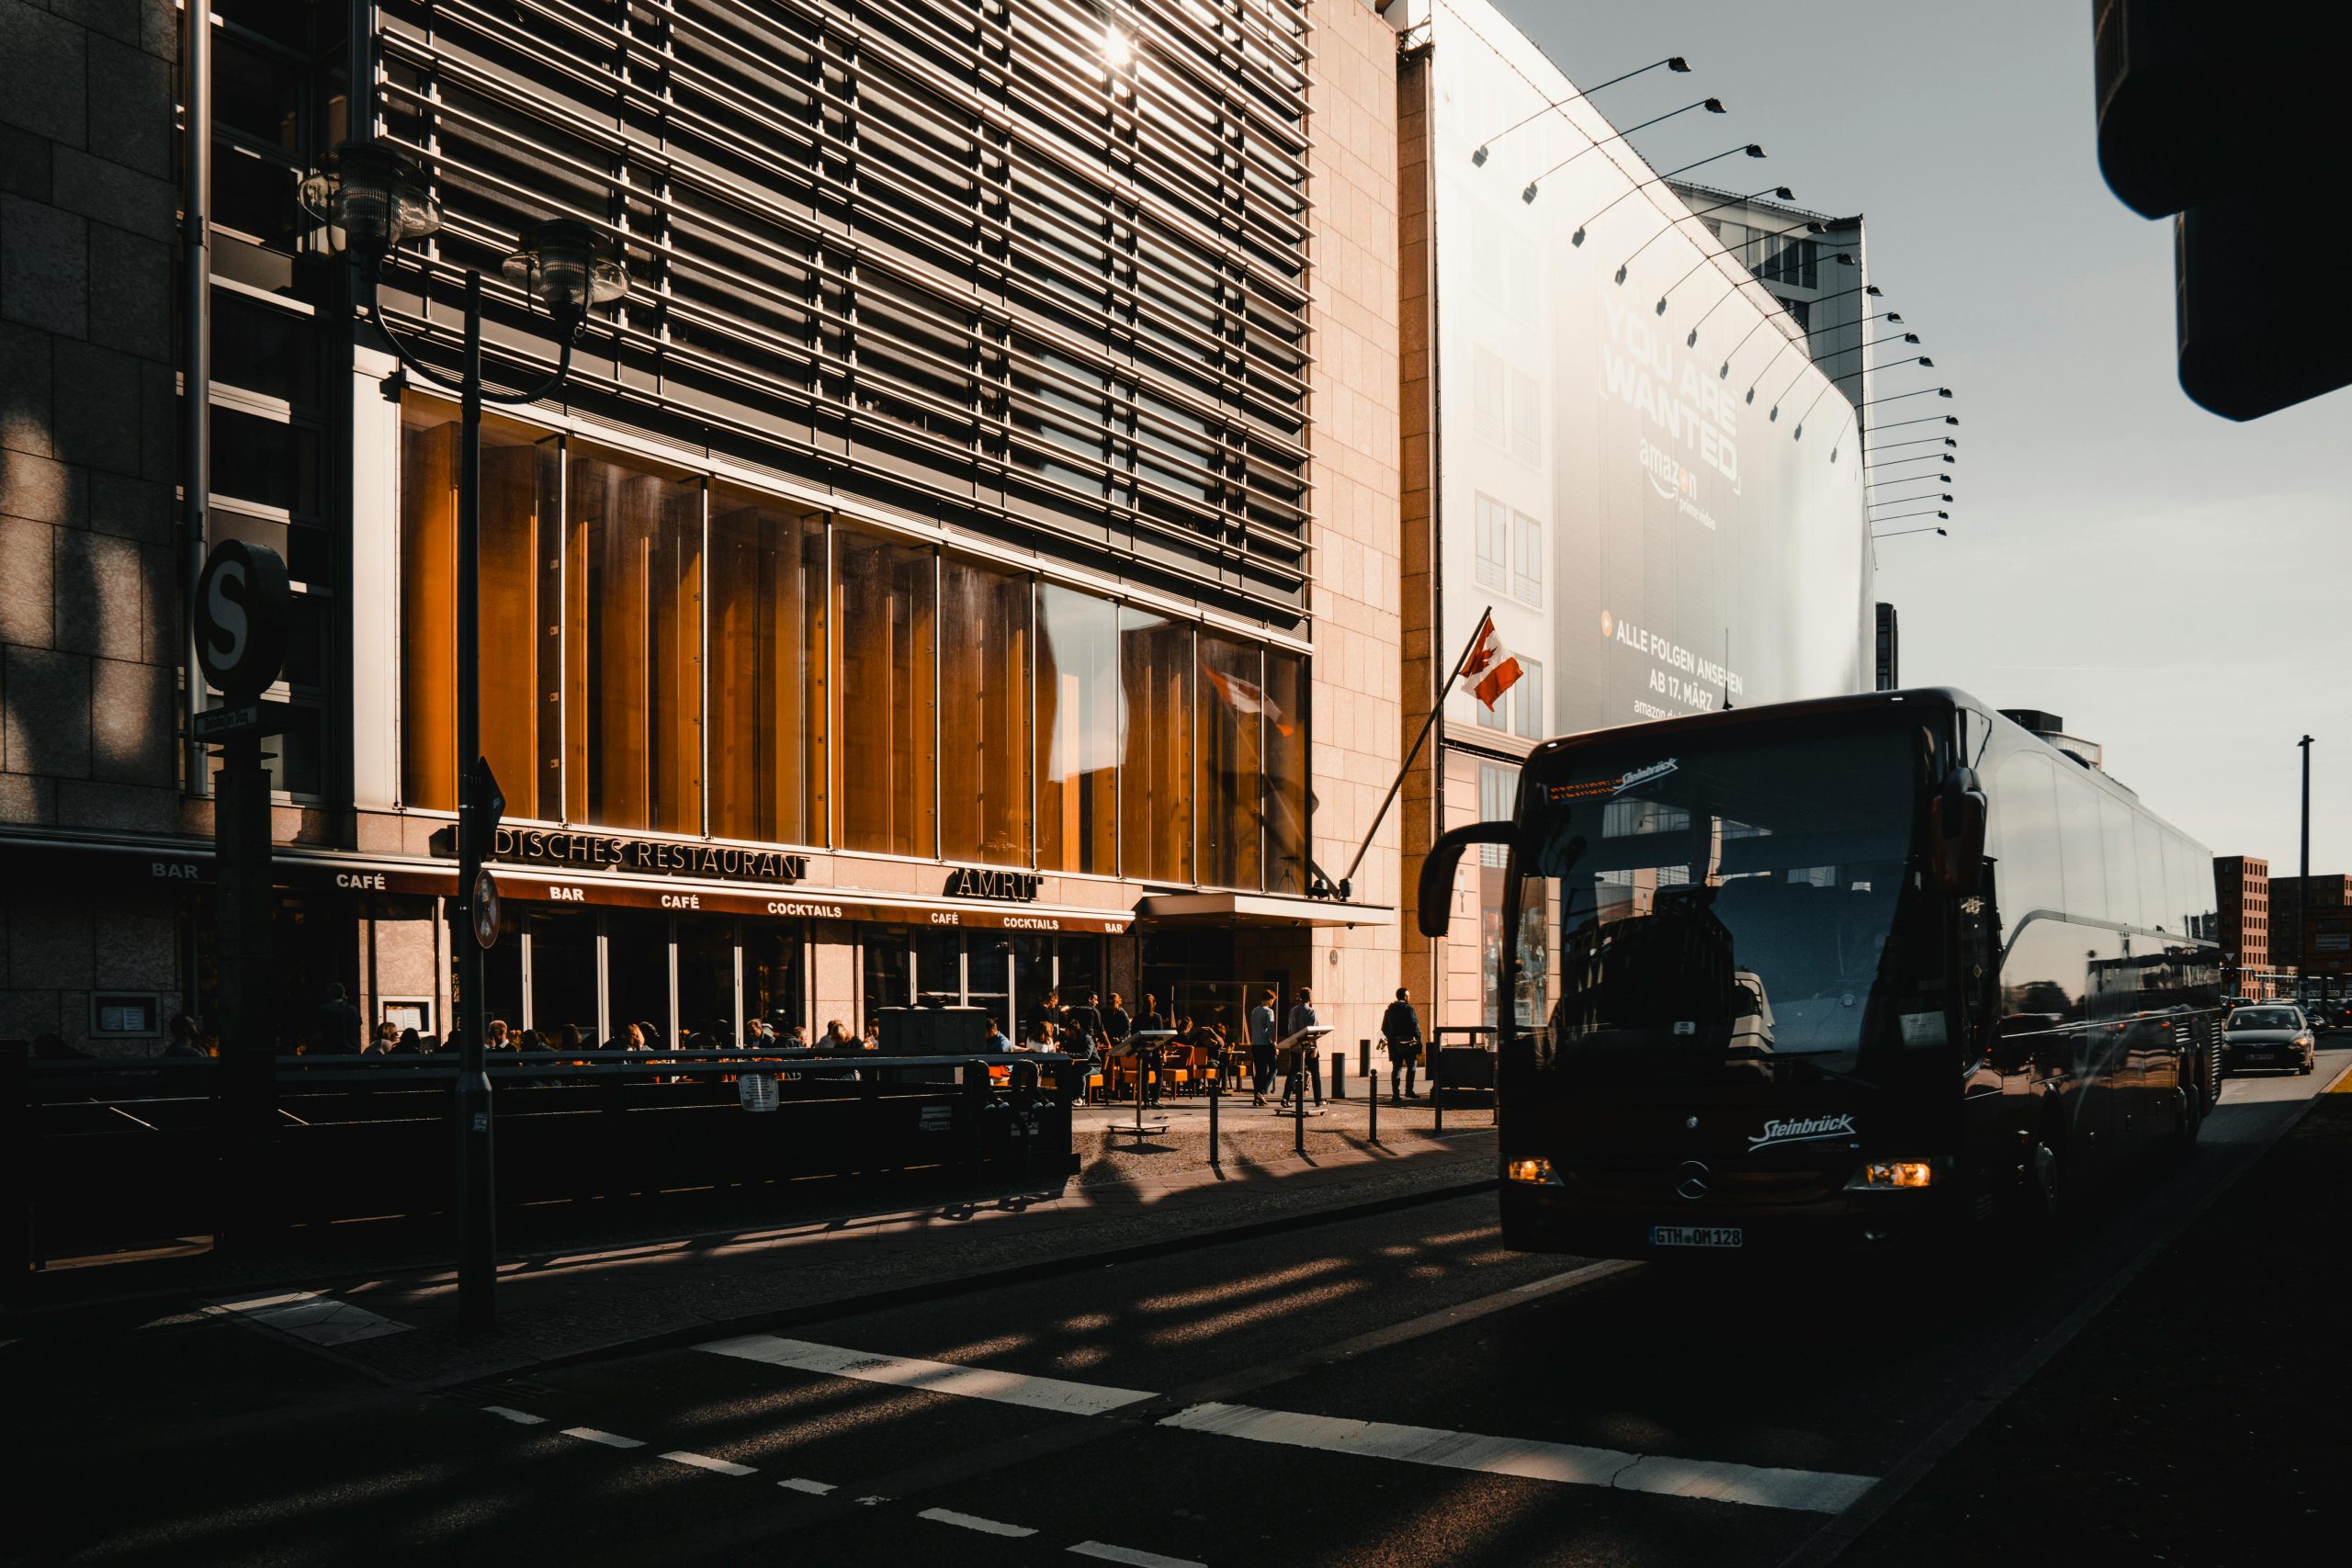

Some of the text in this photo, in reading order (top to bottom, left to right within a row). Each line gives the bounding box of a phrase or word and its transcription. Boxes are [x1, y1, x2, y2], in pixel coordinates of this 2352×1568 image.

[1604, 293, 1674, 384] YOU
[1679, 359, 1737, 437] ARE
[1602, 344, 1738, 482] WANTED
[1640, 438, 1698, 501] amazon
[208, 559, 248, 671] S
[1616, 619, 1743, 696] ALLE FOLGEN ANSEHEN
[1649, 668, 1713, 712] AB 17. MÄRZ
[454, 825, 810, 880] IDISCHES RESTAURANT
[955, 868, 1043, 901] AMRIT
[151, 862, 1124, 933] BAR CAFÉ BAR CAFÉ COCKTAILS CAFÉ COCKTAILS BAR
[1747, 1112, 1857, 1143] Steinbrück
